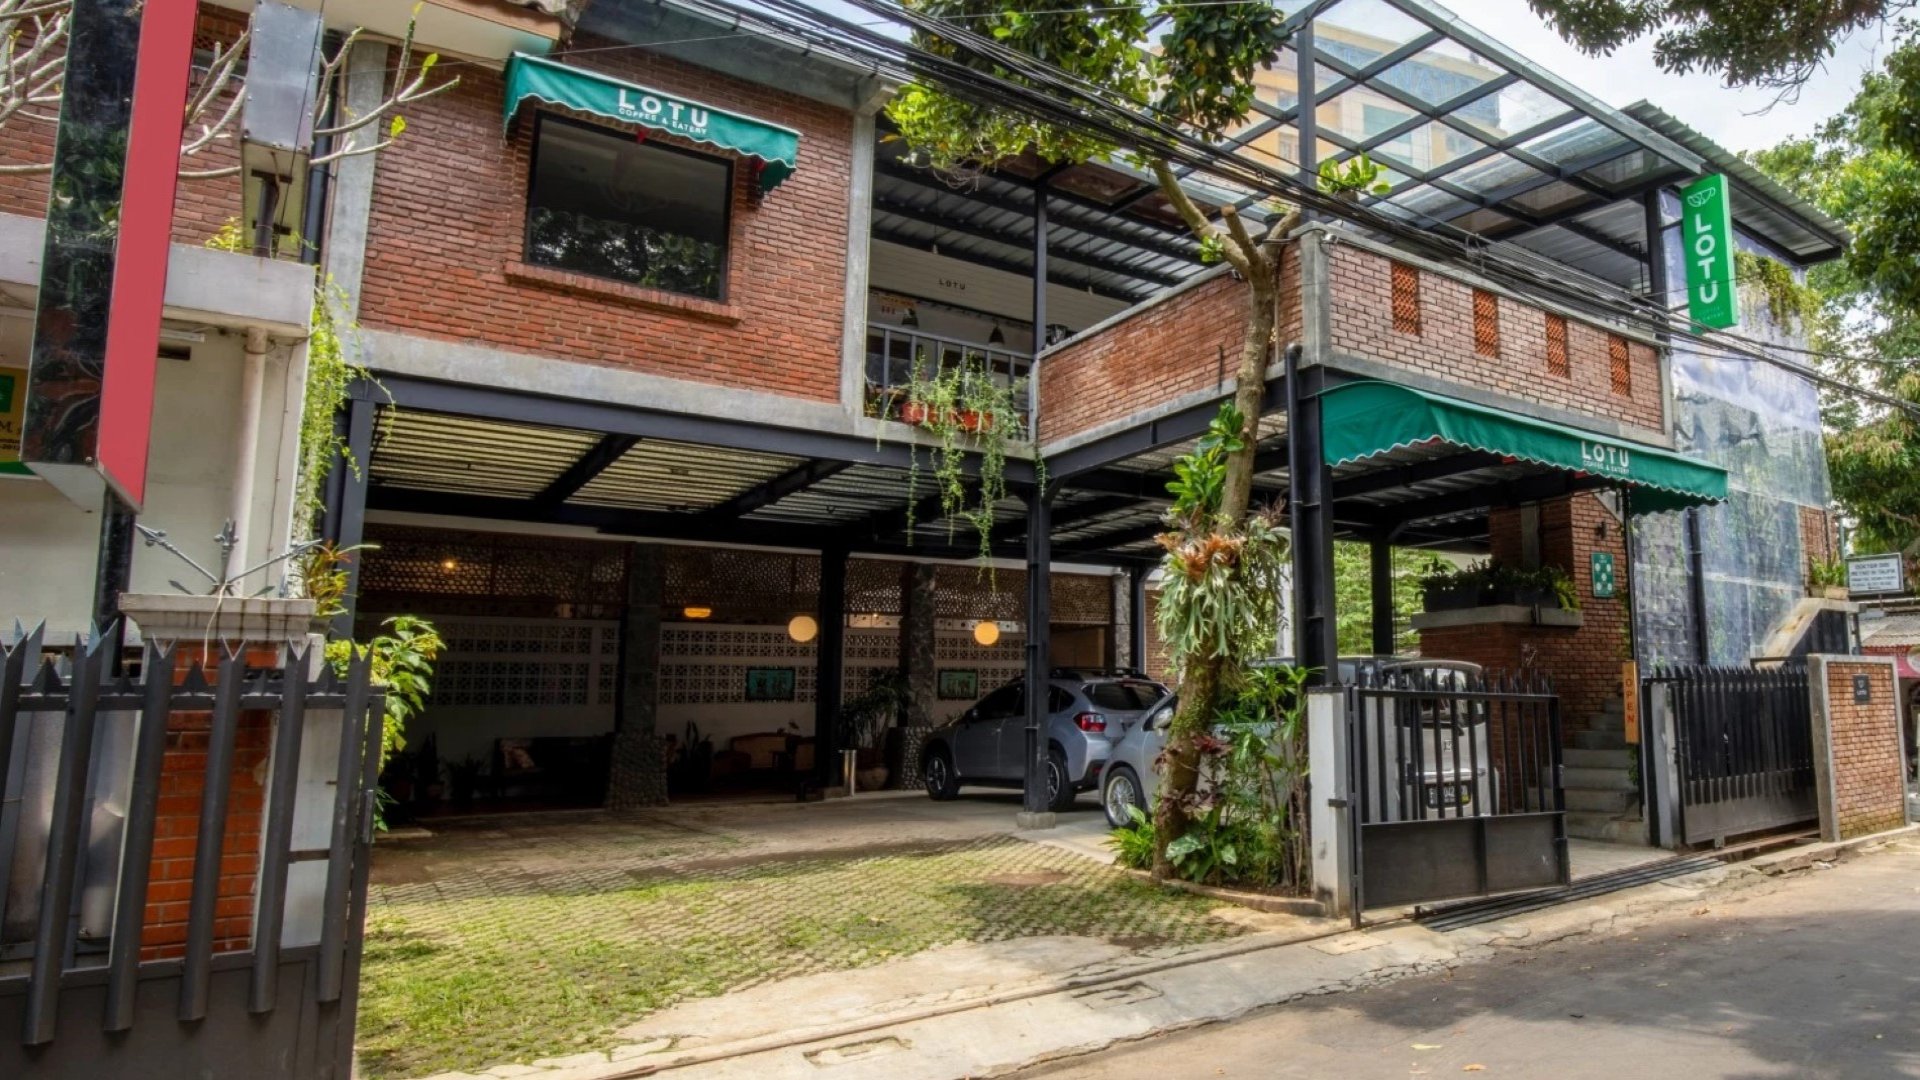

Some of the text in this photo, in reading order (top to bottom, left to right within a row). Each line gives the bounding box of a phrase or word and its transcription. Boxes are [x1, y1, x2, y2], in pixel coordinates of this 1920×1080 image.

[619, 89, 708, 127] LOTU
[619, 107, 657, 121] COFFEE
[672, 121, 707, 135] EATERY
[1695, 213, 1718, 304] LOTU
[938, 277, 966, 290] LOTU
[1581, 440, 1630, 467] LOTU
[1625, 678, 1635, 723] OPEN
